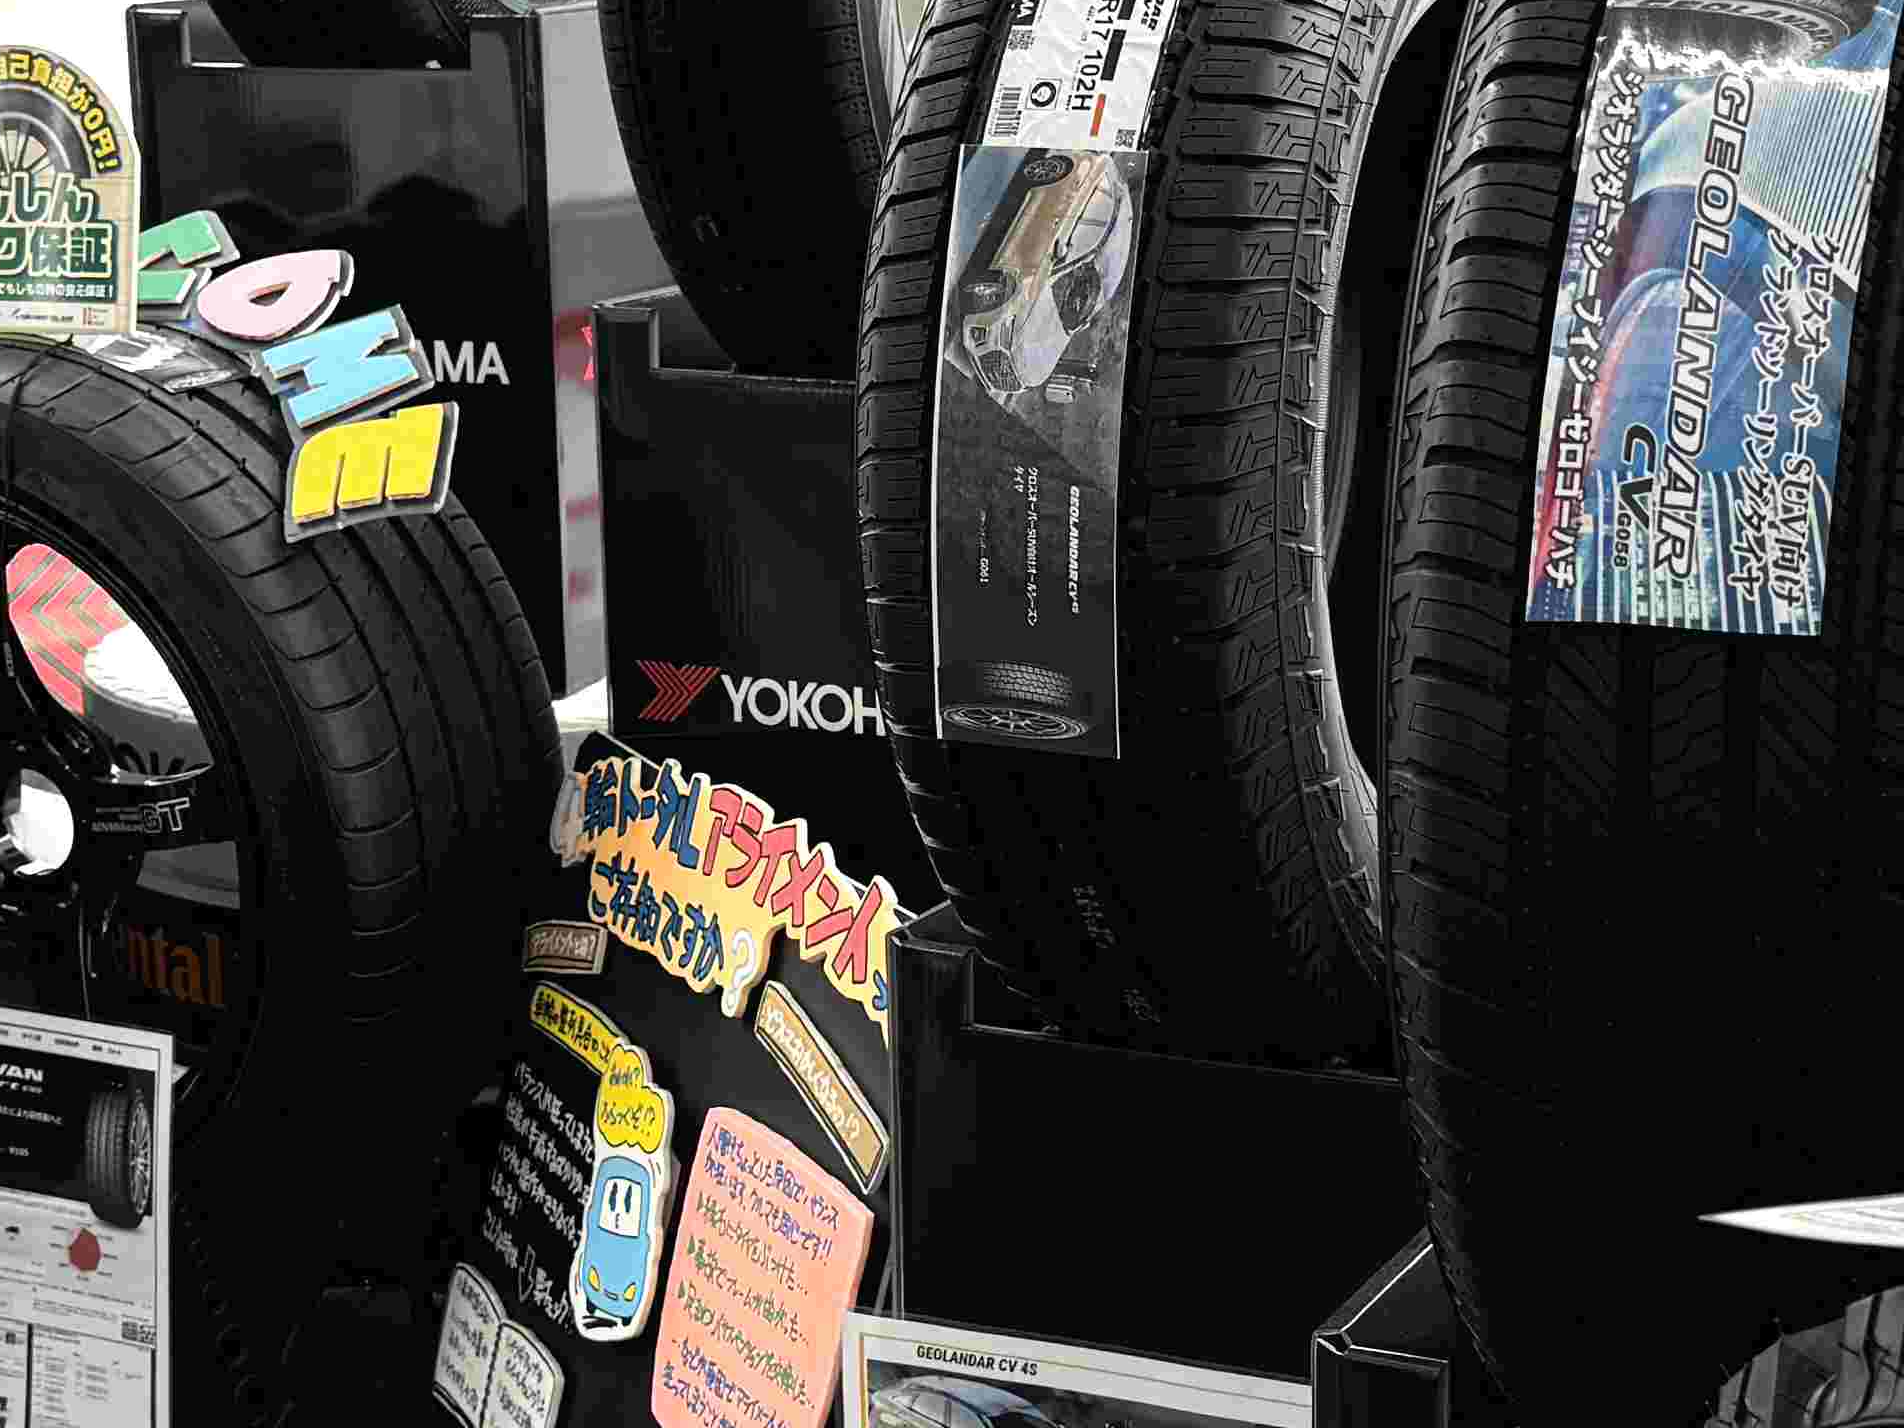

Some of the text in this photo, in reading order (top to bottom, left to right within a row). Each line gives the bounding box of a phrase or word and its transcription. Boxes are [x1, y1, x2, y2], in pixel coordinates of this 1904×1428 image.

[1071, 50, 1103, 113] 102H
[1652, 70, 1755, 580] GEOLANDAR
[1727, 227, 1802, 602] グランドツーリングタイヤ
[1768, 232, 1842, 606] クロスオーバーSUV向け
[1613, 421, 1660, 570] CV G058
[916, 1343, 1039, 1377] GEOLANDAR CV 4S
